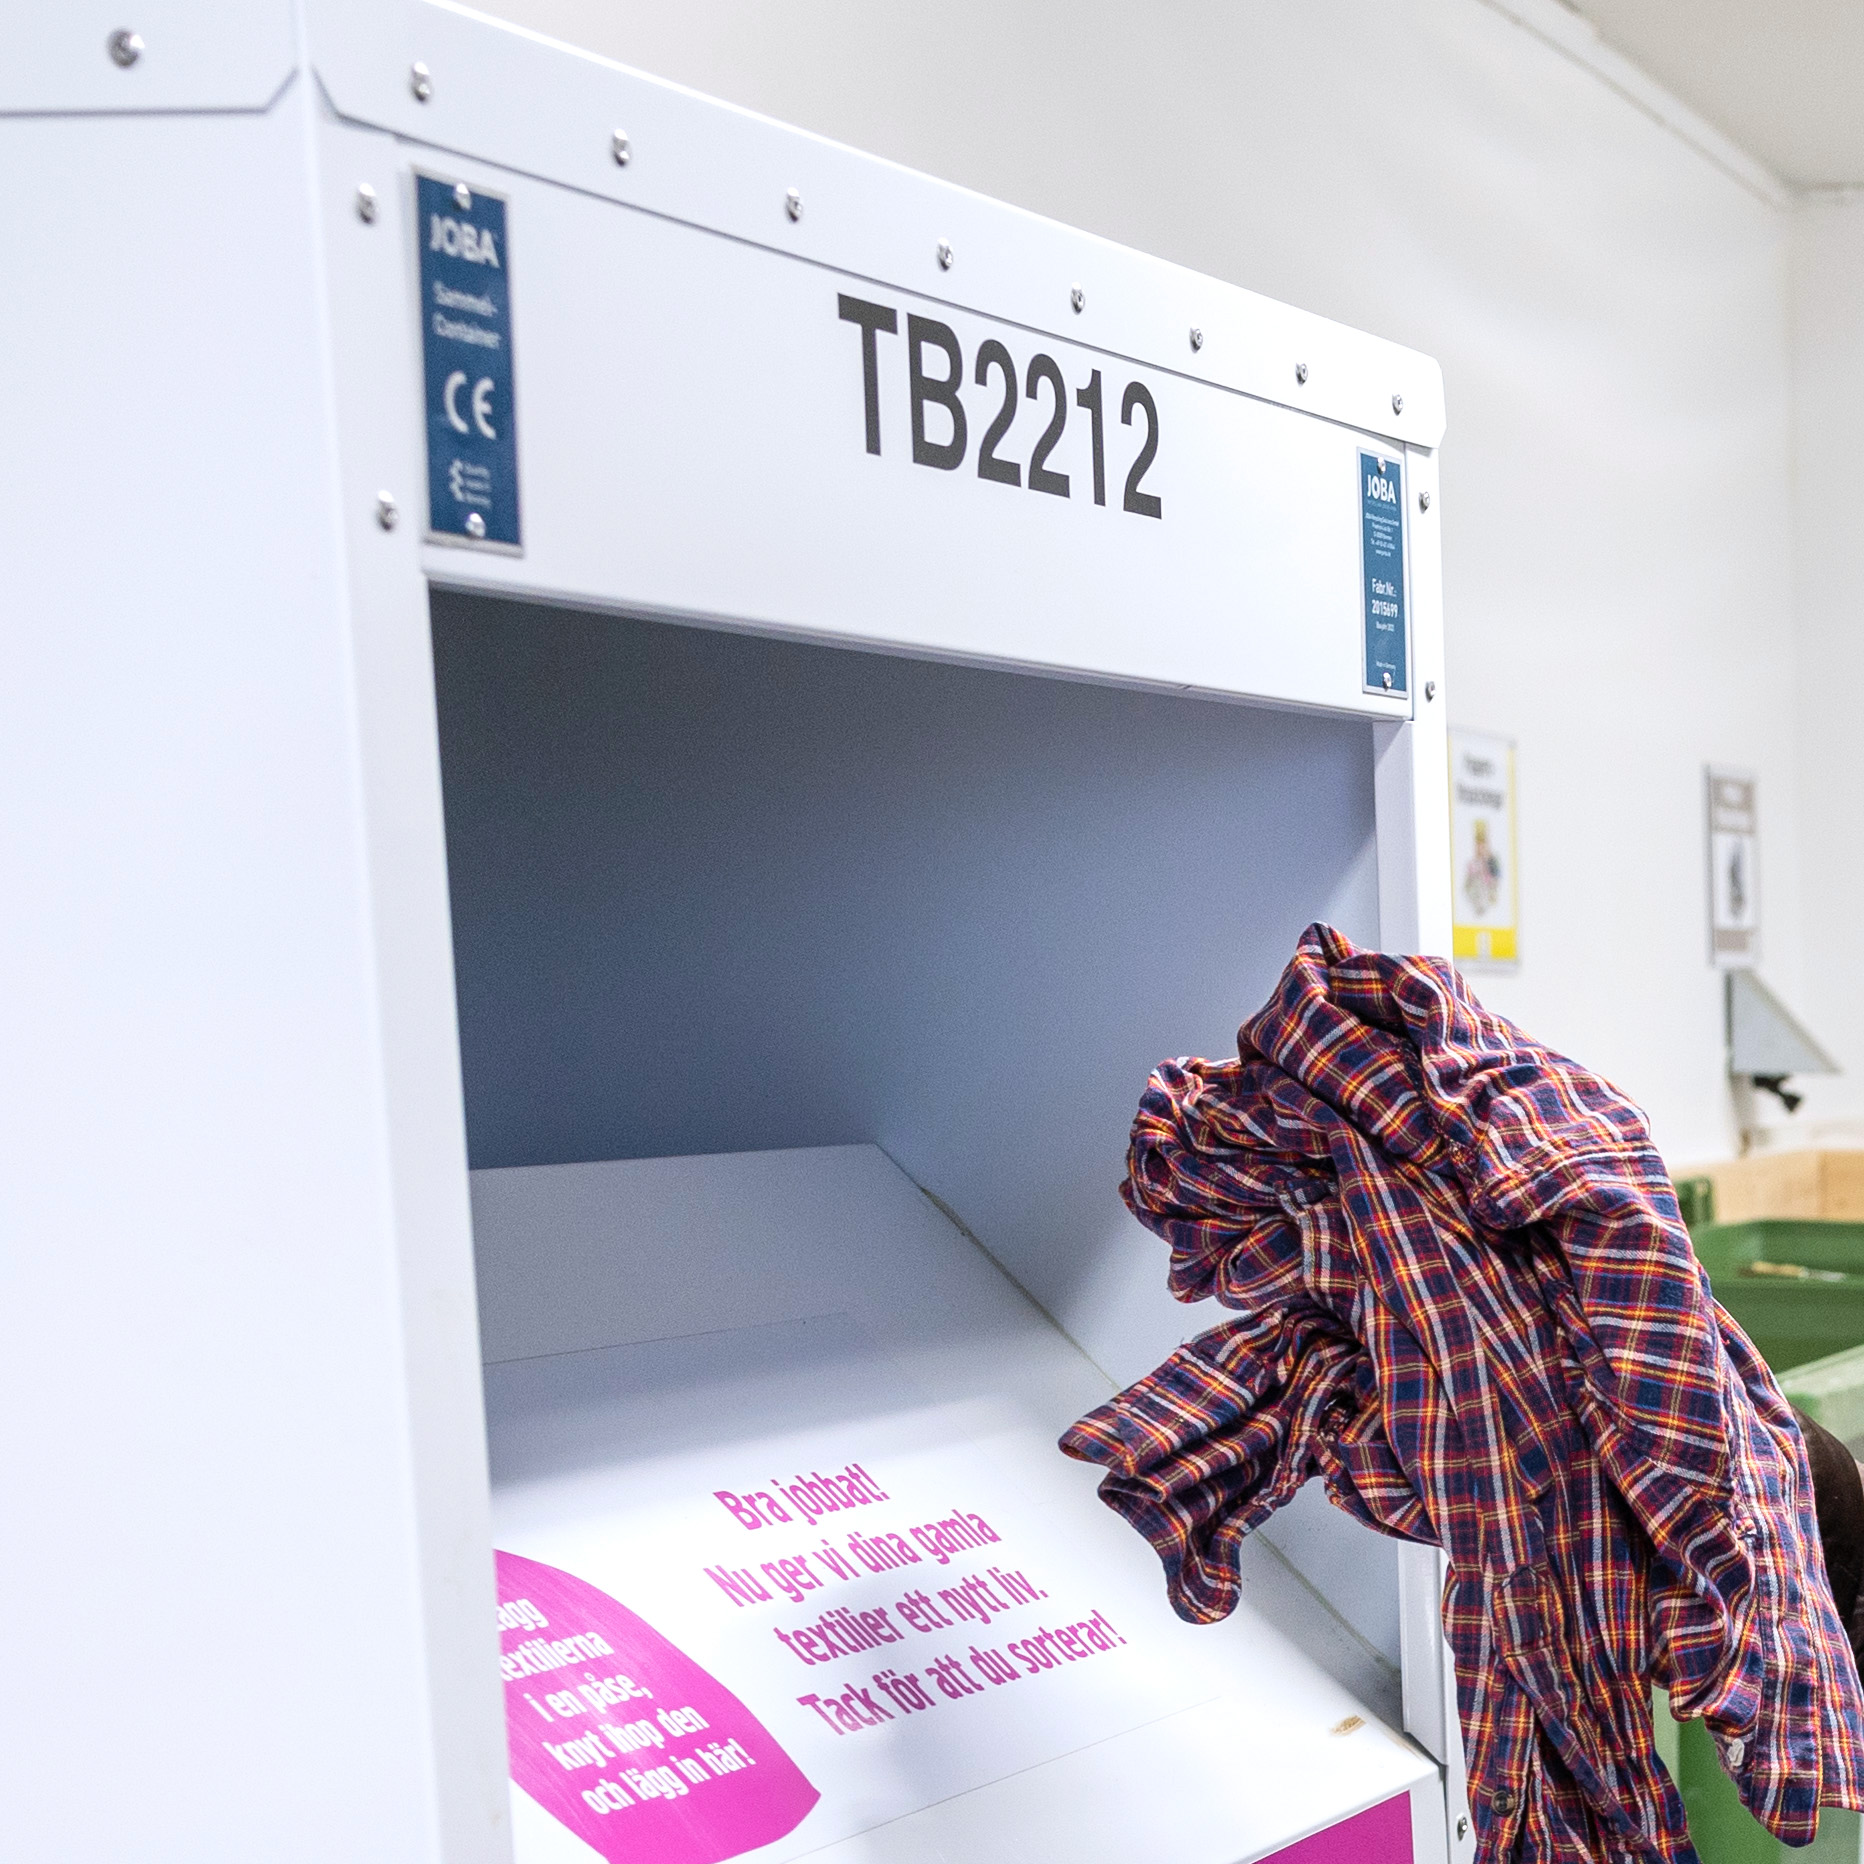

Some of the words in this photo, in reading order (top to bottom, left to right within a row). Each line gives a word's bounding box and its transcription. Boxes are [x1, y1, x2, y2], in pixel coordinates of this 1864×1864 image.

[430, 213, 500, 268] JOBA
[837, 294, 1162, 519] TB2212
[1367, 474, 1396, 504] JOBA
[713, 1490, 793, 1530] Bra
[770, 1463, 890, 1525] jobbat!
[703, 1566, 773, 1607] Nu
[761, 1554, 824, 1603] ger
[813, 1538, 859, 1581] vi
[847, 1530, 922, 1572] dina
[909, 1509, 1002, 1563] gamla
[773, 1607, 904, 1665] textilier
[895, 1590, 953, 1634] ett
[937, 1572, 1011, 1625] nytt
[989, 1567, 1049, 1612] liv.
[523, 1692, 555, 1722] i
[545, 1689, 588, 1717] en
[577, 1672, 653, 1714] påse,
[797, 1683, 888, 1735] Tack
[873, 1669, 935, 1713] för
[925, 1656, 984, 1699] att
[968, 1646, 1021, 1686] du
[1008, 1609, 1127, 1674] sorterar!
[542, 1730, 610, 1771] knyt
[598, 1717, 665, 1758] ihop
[657, 1705, 710, 1738] den
[581, 1779, 635, 1814] och
[619, 1765, 690, 1801] lägg
[669, 1755, 710, 1783] in
[694, 1737, 756, 1777] här!
